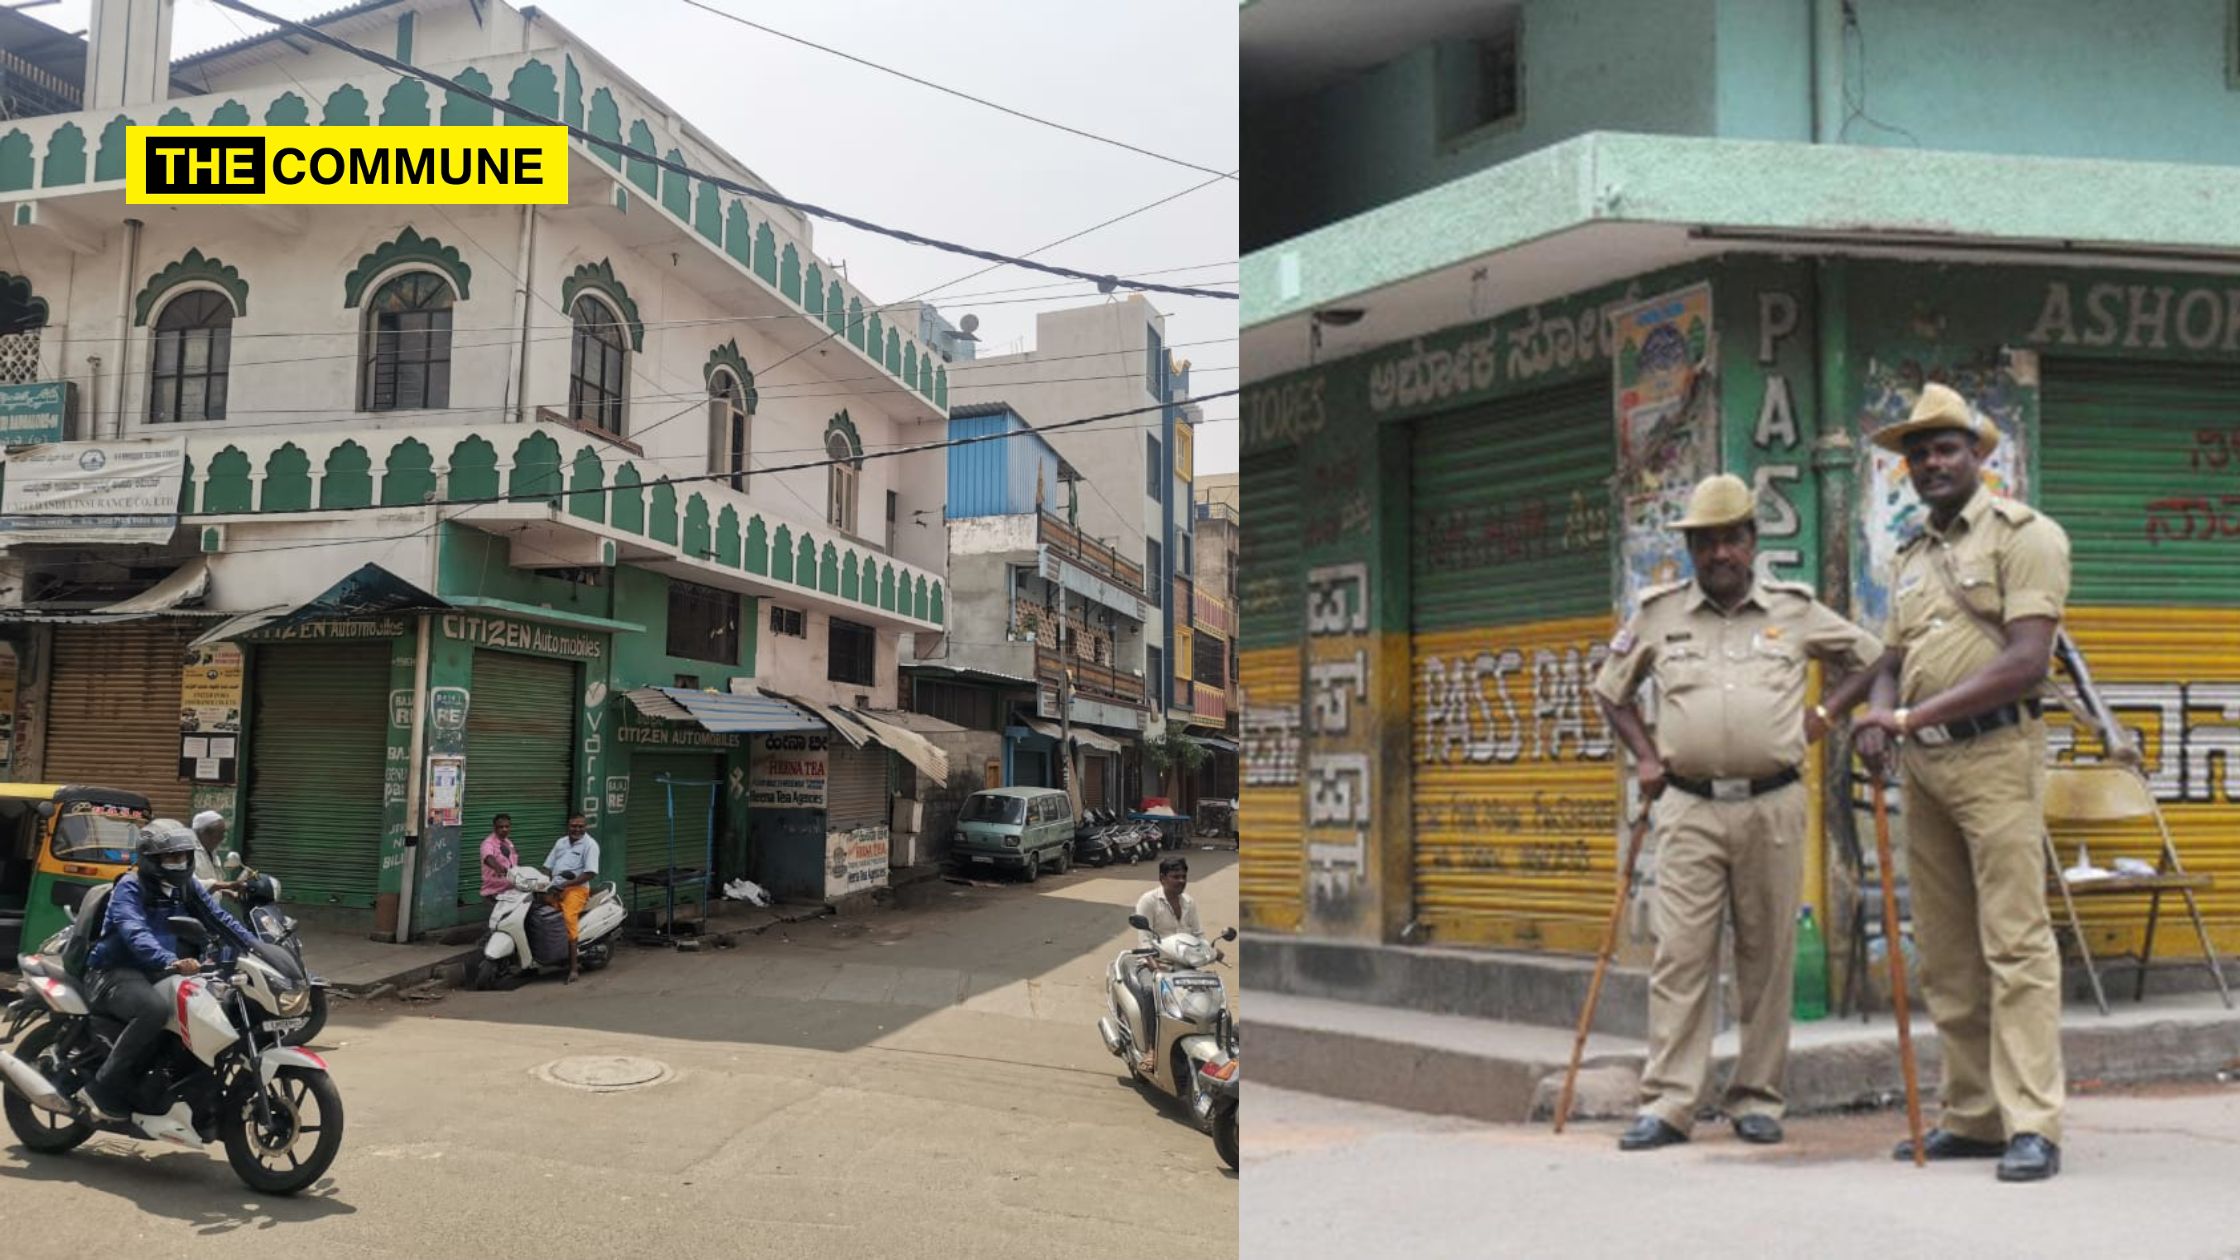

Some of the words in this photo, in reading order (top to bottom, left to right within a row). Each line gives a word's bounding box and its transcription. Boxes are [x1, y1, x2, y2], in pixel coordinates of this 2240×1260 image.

[442, 614, 530, 649] CITIZEN
[436, 708, 461, 724] RE
[1424, 652, 1524, 763] PASS
[618, 726, 669, 744] CITIZEN
[672, 731, 741, 748] AUTOMOBILES
[804, 760, 826, 777] TEA
[608, 793, 626, 808] RE
[776, 790, 792, 803] Tea
